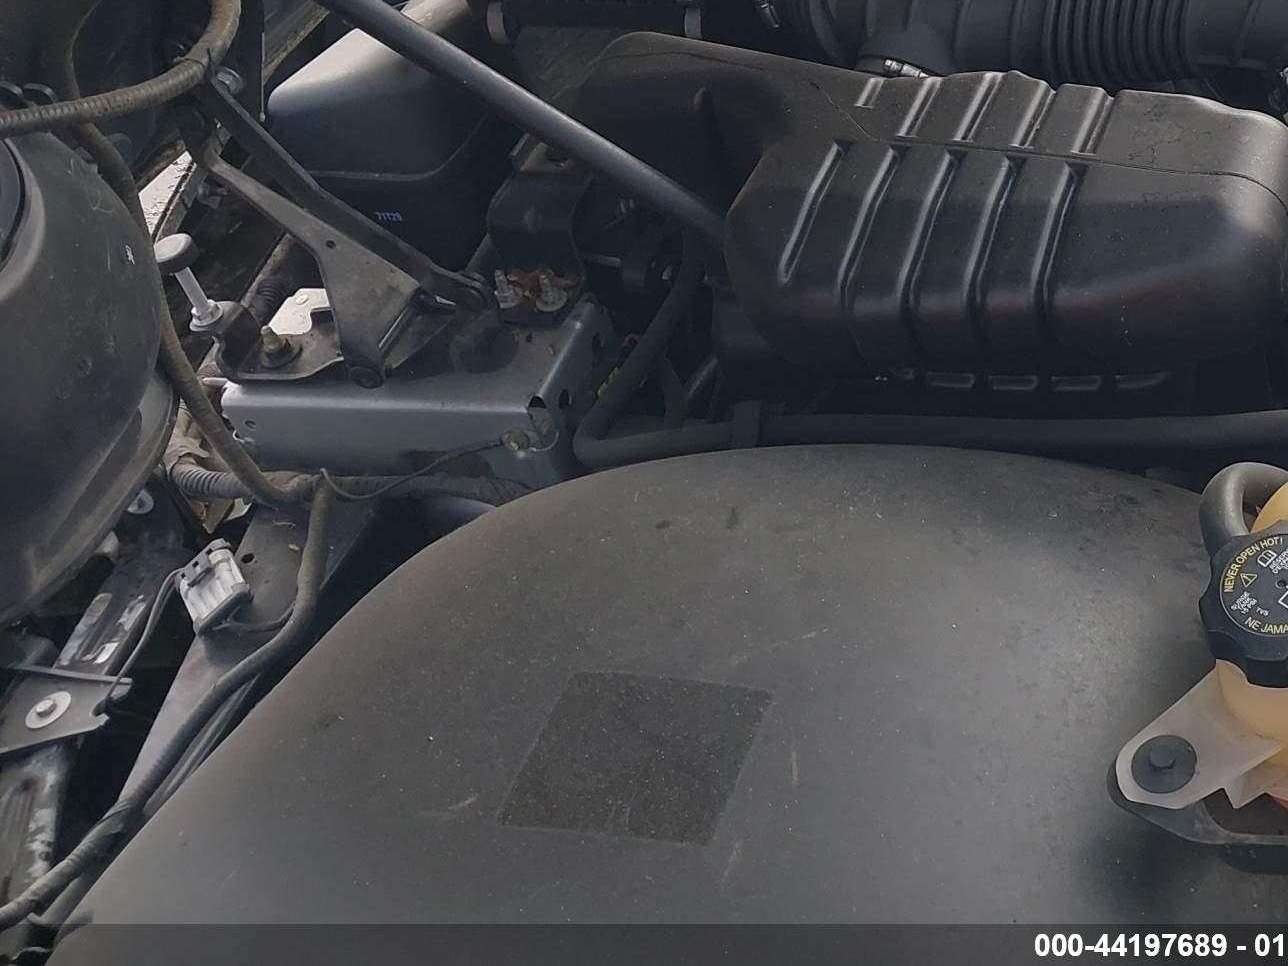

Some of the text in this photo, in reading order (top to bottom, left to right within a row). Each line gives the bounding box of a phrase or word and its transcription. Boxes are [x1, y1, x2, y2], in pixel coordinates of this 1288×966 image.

[1223, 536, 1283, 593] NEVER OPEN HOT!
[1244, 616, 1262, 631] NE
